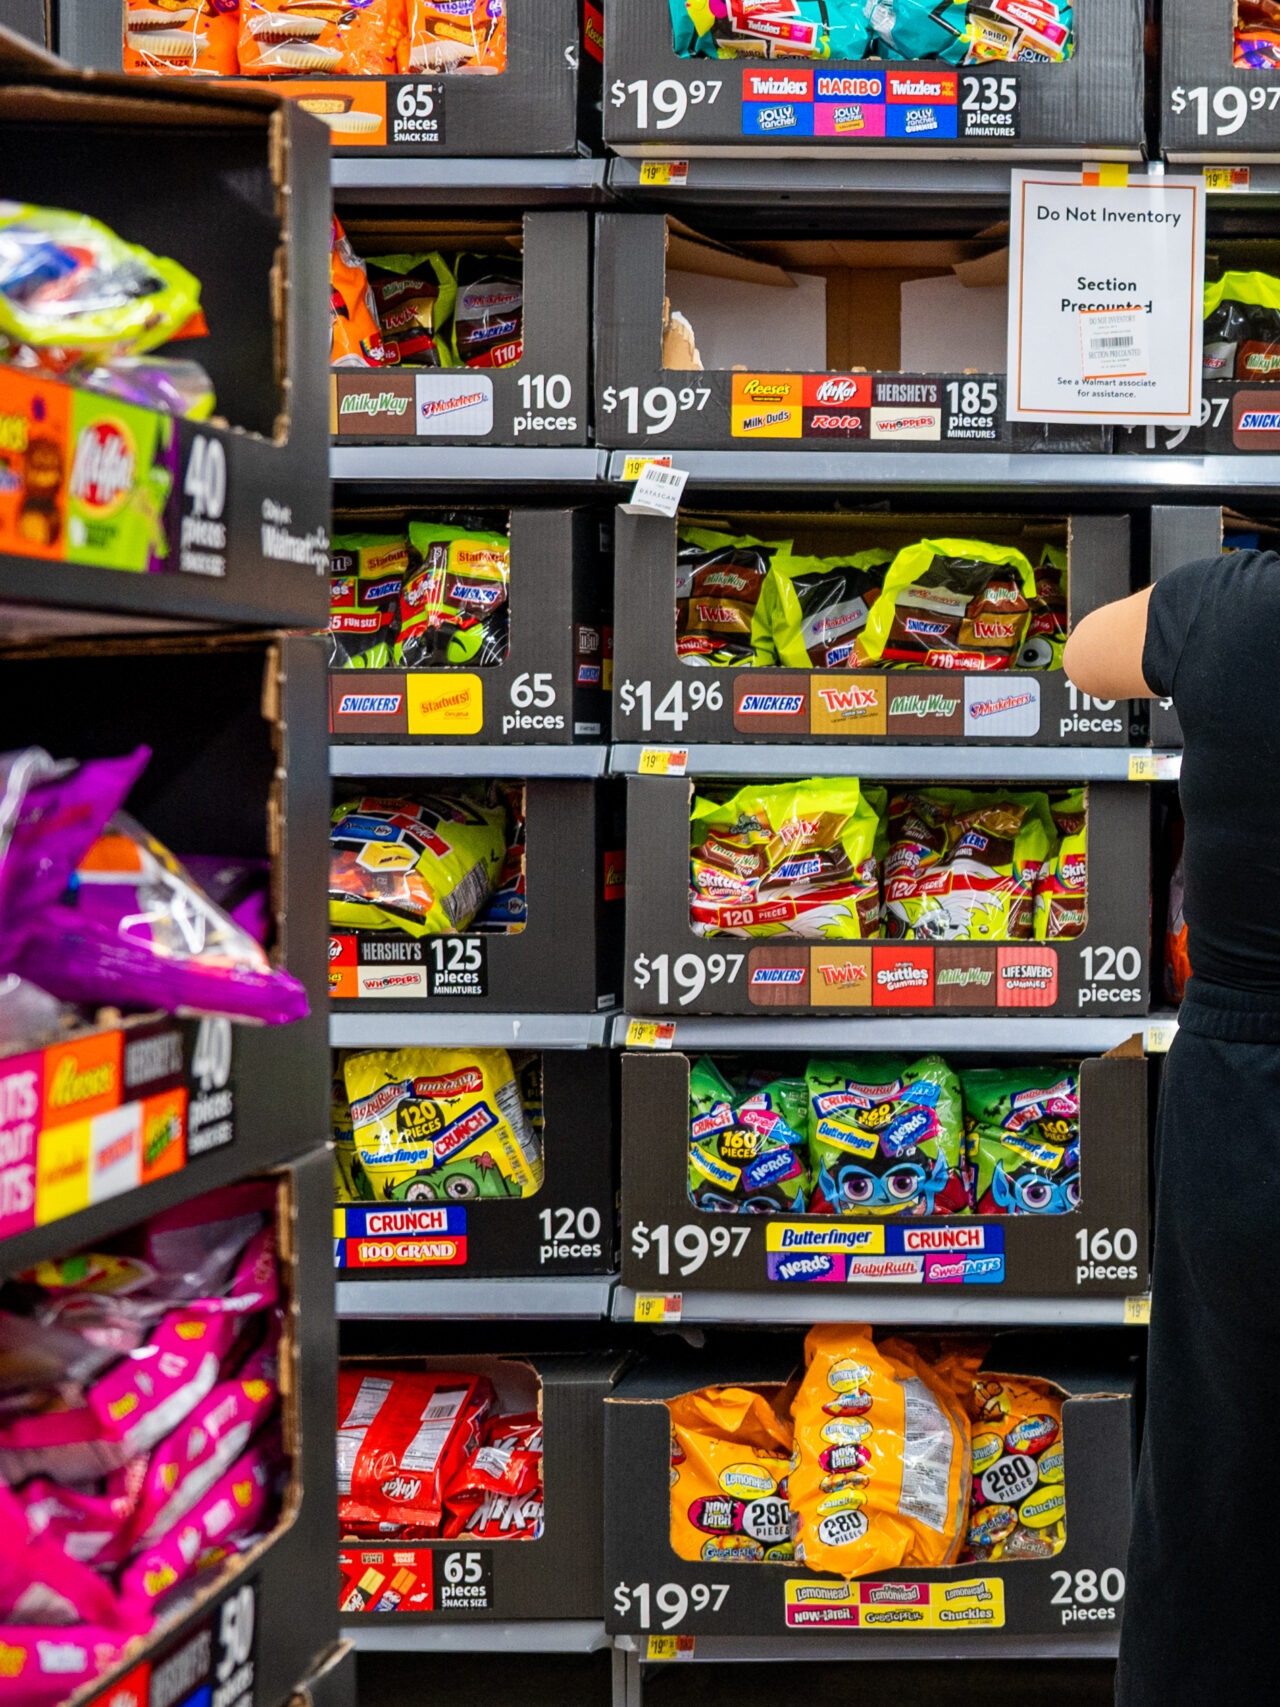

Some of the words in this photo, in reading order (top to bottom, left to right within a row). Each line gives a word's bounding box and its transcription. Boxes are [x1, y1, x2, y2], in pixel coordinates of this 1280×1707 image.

[750, 78, 808, 95] Twizzlers
[819, 78, 881, 95] HARIBO
[890, 80, 941, 96] Twizzlers
[963, 78, 1017, 110] 235
[397, 84, 434, 116] 65
[759, 106, 794, 120] JOLLY
[833, 106, 860, 120] JOLLY
[905, 108, 933, 119] JOLLY
[967, 111, 1012, 125] pieces
[394, 117, 437, 132] pieces
[965, 127, 1015, 136] MINIATURES
[394, 134, 420, 142] SNACK
[422, 134, 439, 142] SIZE
[1037, 206, 1060, 221] Do
[1066, 207, 1096, 222] Not
[1103, 208, 1181, 227] Inventory
[1077, 277, 1136, 291] Section
[495, 345, 515, 363] 110
[1057, 377, 1072, 385] See
[1082, 378, 1117, 386] Walmart
[1119, 379, 1157, 387] associate
[517, 375, 571, 409] 110
[878, 385, 936, 402] HERSHEY'S
[946, 382, 998, 414] 185
[1078, 389, 1090, 397] for
[1093, 390, 1136, 398] assistance.
[514, 412, 577, 435] pieces
[743, 417, 763, 430] Milk
[766, 410, 790, 424] Duds
[949, 416, 993, 429] pieces
[947, 430, 995, 439] MINIATURES
[344, 618, 359, 627] FUN
[361, 618, 377, 627] SIZE
[908, 620, 949, 634] SNICKERS
[931, 654, 952, 668] 110
[510, 673, 555, 707] 65
[342, 697, 399, 711] SNICKERS
[743, 698, 801, 711] SNICKERS
[819, 686, 876, 712] Twix
[503, 710, 564, 734] pieces
[1059, 717, 1122, 737] pieces
[891, 881, 916, 898] 120
[723, 909, 754, 925] 120
[759, 907, 787, 919] PIECES
[363, 944, 422, 960] HERSHEY'S
[430, 939, 482, 970] 125
[819, 962, 867, 983] Twix
[1079, 947, 1141, 981] 120
[364, 974, 420, 988] WHOPPERS
[436, 971, 478, 984] pieces
[754, 970, 803, 982] SNICKERS
[877, 968, 928, 982] Skittles
[1002, 967, 1023, 979] LIFE
[1024, 967, 1052, 979] SAVERS
[434, 986, 482, 994] MINIATURES
[887, 979, 928, 990] Gummies
[1079, 983, 1141, 1007] pieces
[418, 1080, 441, 1092] 100
[820, 1095, 868, 1108] CRUNCH
[401, 1102, 436, 1126] 120
[436, 1109, 485, 1155] CRUNCH
[693, 1114, 731, 1134] CRUNCH
[1041, 1120, 1068, 1133] 160
[723, 1131, 757, 1147] 160
[819, 1122, 875, 1149] Butterfinger
[722, 1148, 756, 1157] PIECES
[370, 1212, 442, 1232] CRUNCH
[539, 1208, 600, 1240] 120
[782, 1229, 872, 1246] Butterfinger
[908, 1231, 979, 1248] CRUNCH
[1076, 1228, 1137, 1261] 160
[360, 1244, 393, 1258] 100
[396, 1244, 452, 1258] GRAND
[540, 1242, 601, 1264] pieces
[1077, 1263, 1137, 1282] pieces
[987, 1456, 1031, 1492] 280
[999, 1477, 1033, 1500] PIECES
[825, 1512, 860, 1537] 280
[444, 1553, 482, 1583] 65
[442, 1584, 486, 1598] pieces
[1051, 1568, 1125, 1604] 280
[442, 1599, 468, 1607] SNACK
[470, 1599, 487, 1607] SIZE
[941, 1609, 992, 1620] Chuckles
[1062, 1607, 1116, 1625] pieces
